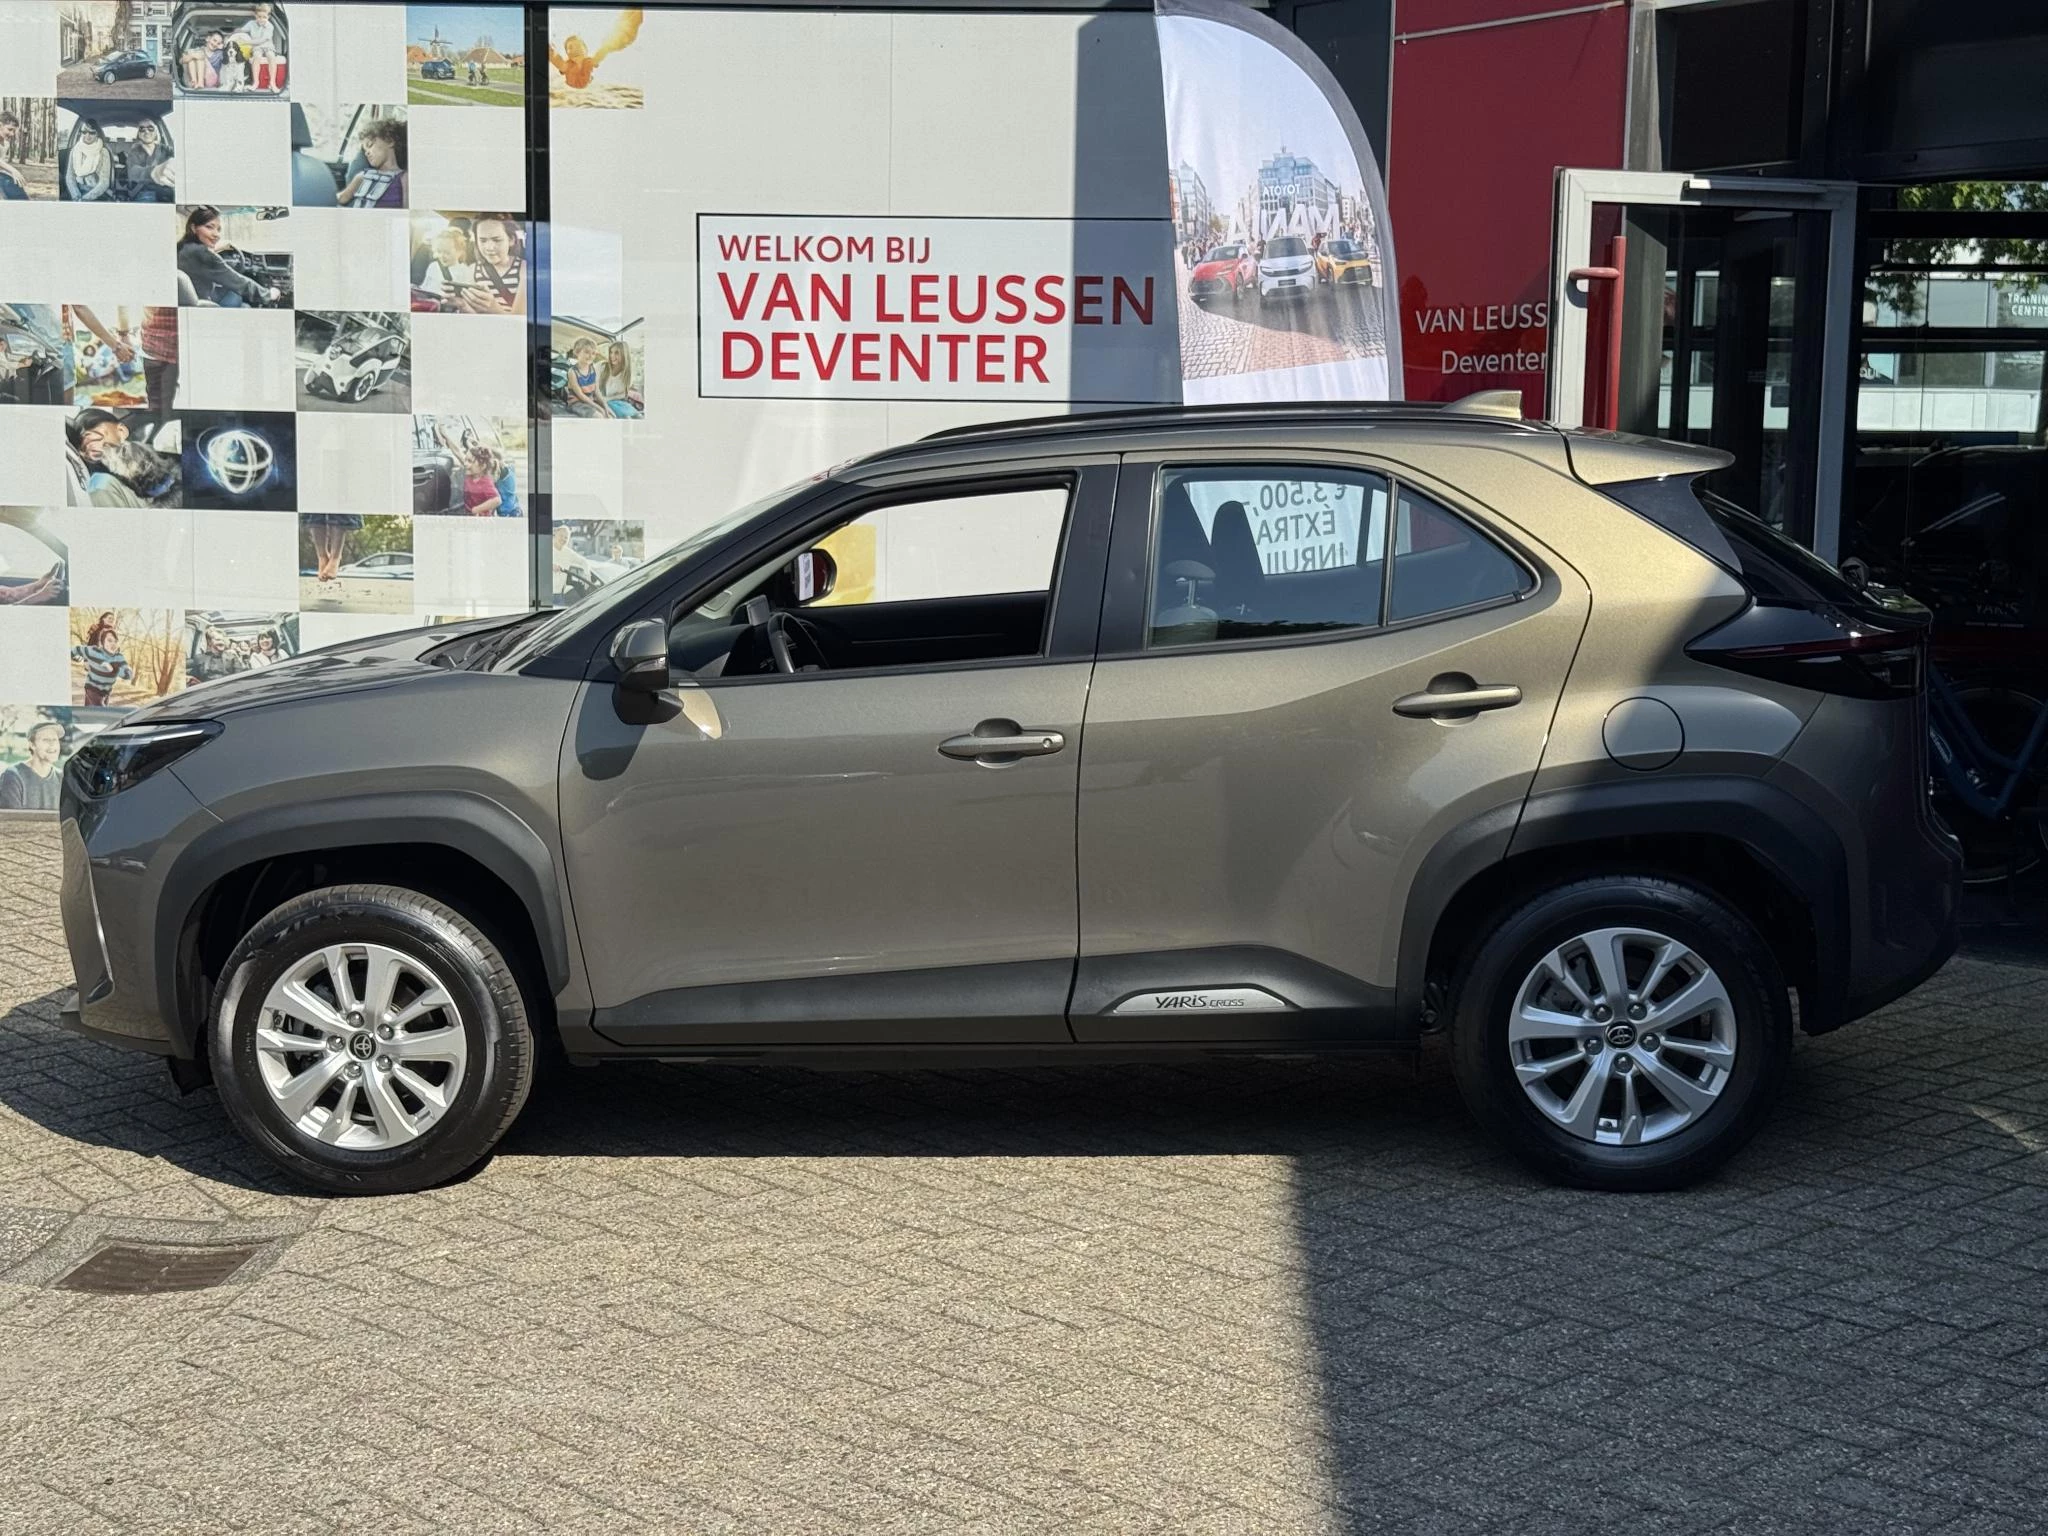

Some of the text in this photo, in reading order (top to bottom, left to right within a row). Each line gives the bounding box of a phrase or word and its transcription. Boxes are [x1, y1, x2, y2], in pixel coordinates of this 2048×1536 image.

[718, 235, 931, 264] WELKOM BIJ
[717, 272, 1154, 325] VAN LEUSSEN
[2011, 305, 2048, 317] CENTRE
[1415, 307, 1465, 334] VAN
[722, 331, 1050, 384] DEVENTER
[1441, 349, 1548, 375] Deventer
[1155, 994, 1244, 1008] YARIS CROSS
